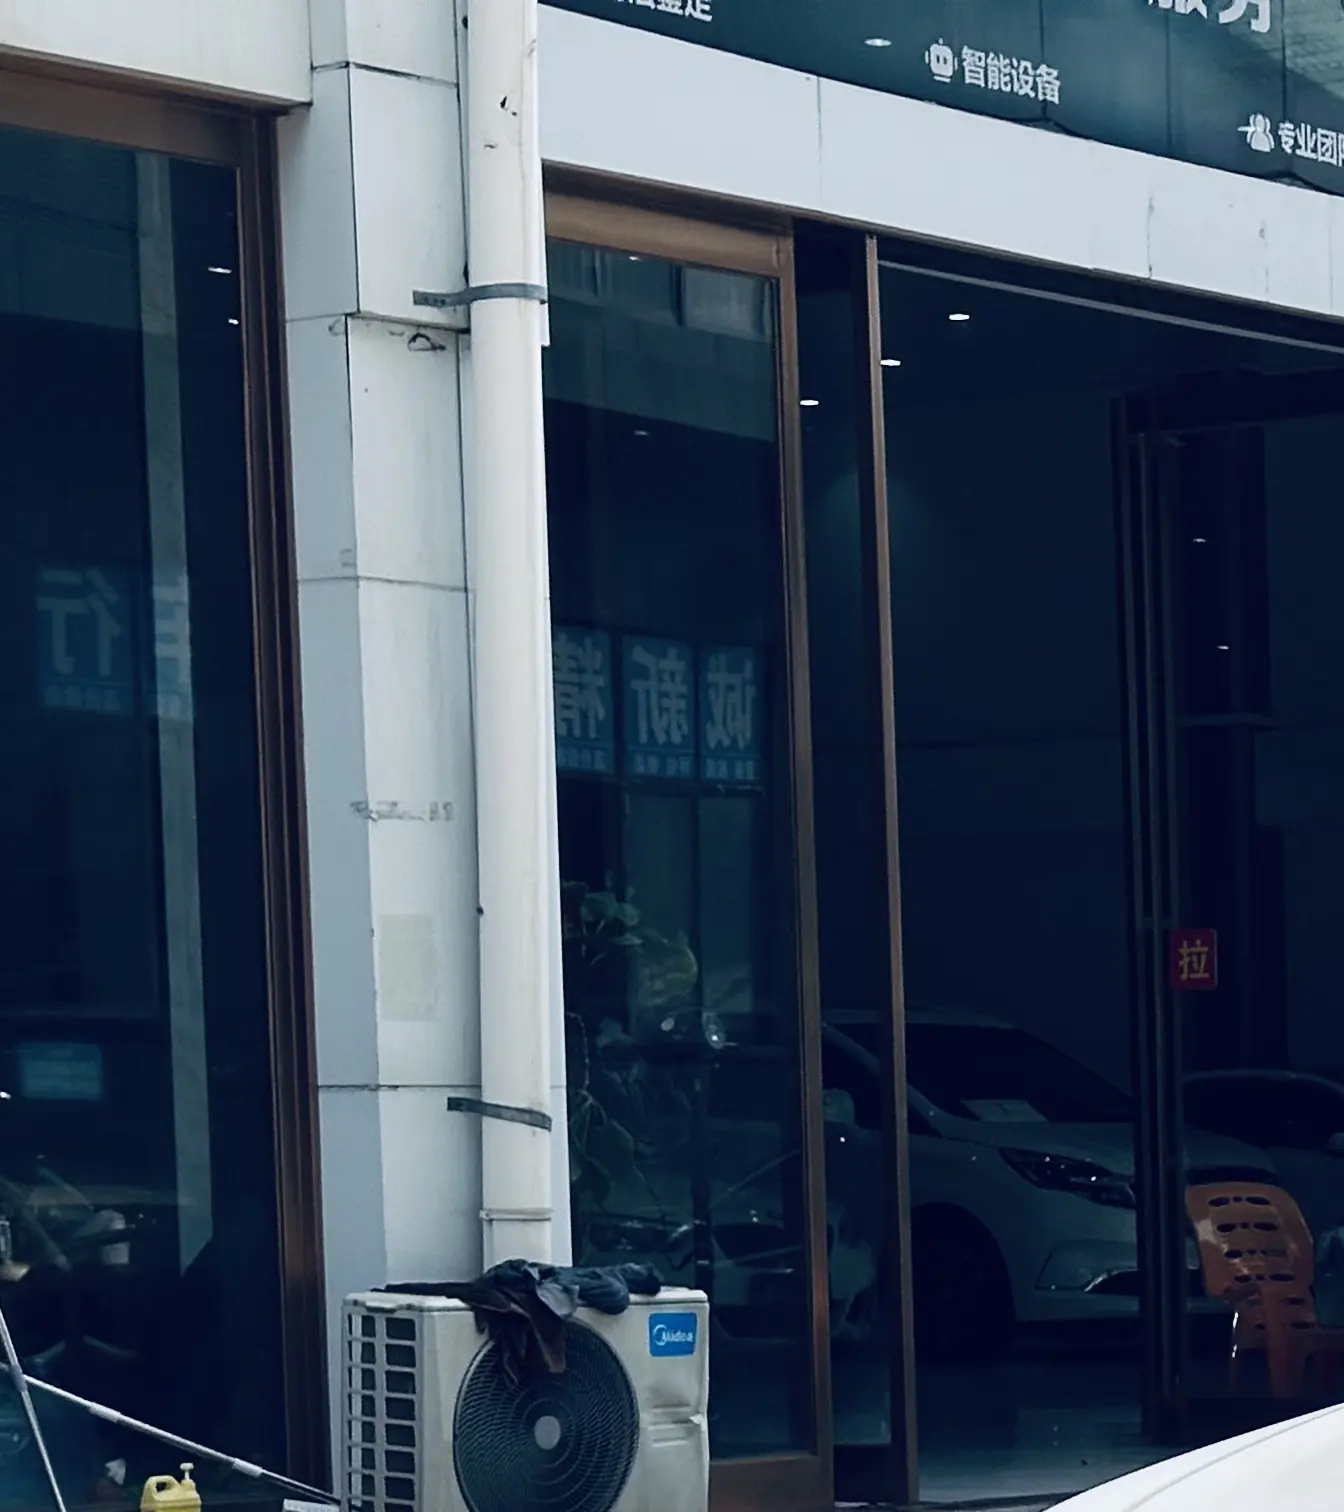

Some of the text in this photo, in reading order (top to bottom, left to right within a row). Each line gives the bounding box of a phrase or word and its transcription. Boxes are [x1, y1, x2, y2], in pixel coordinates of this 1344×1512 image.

[961, 45, 1061, 104] 智能设备
[1178, 939, 1210, 981] 拉
